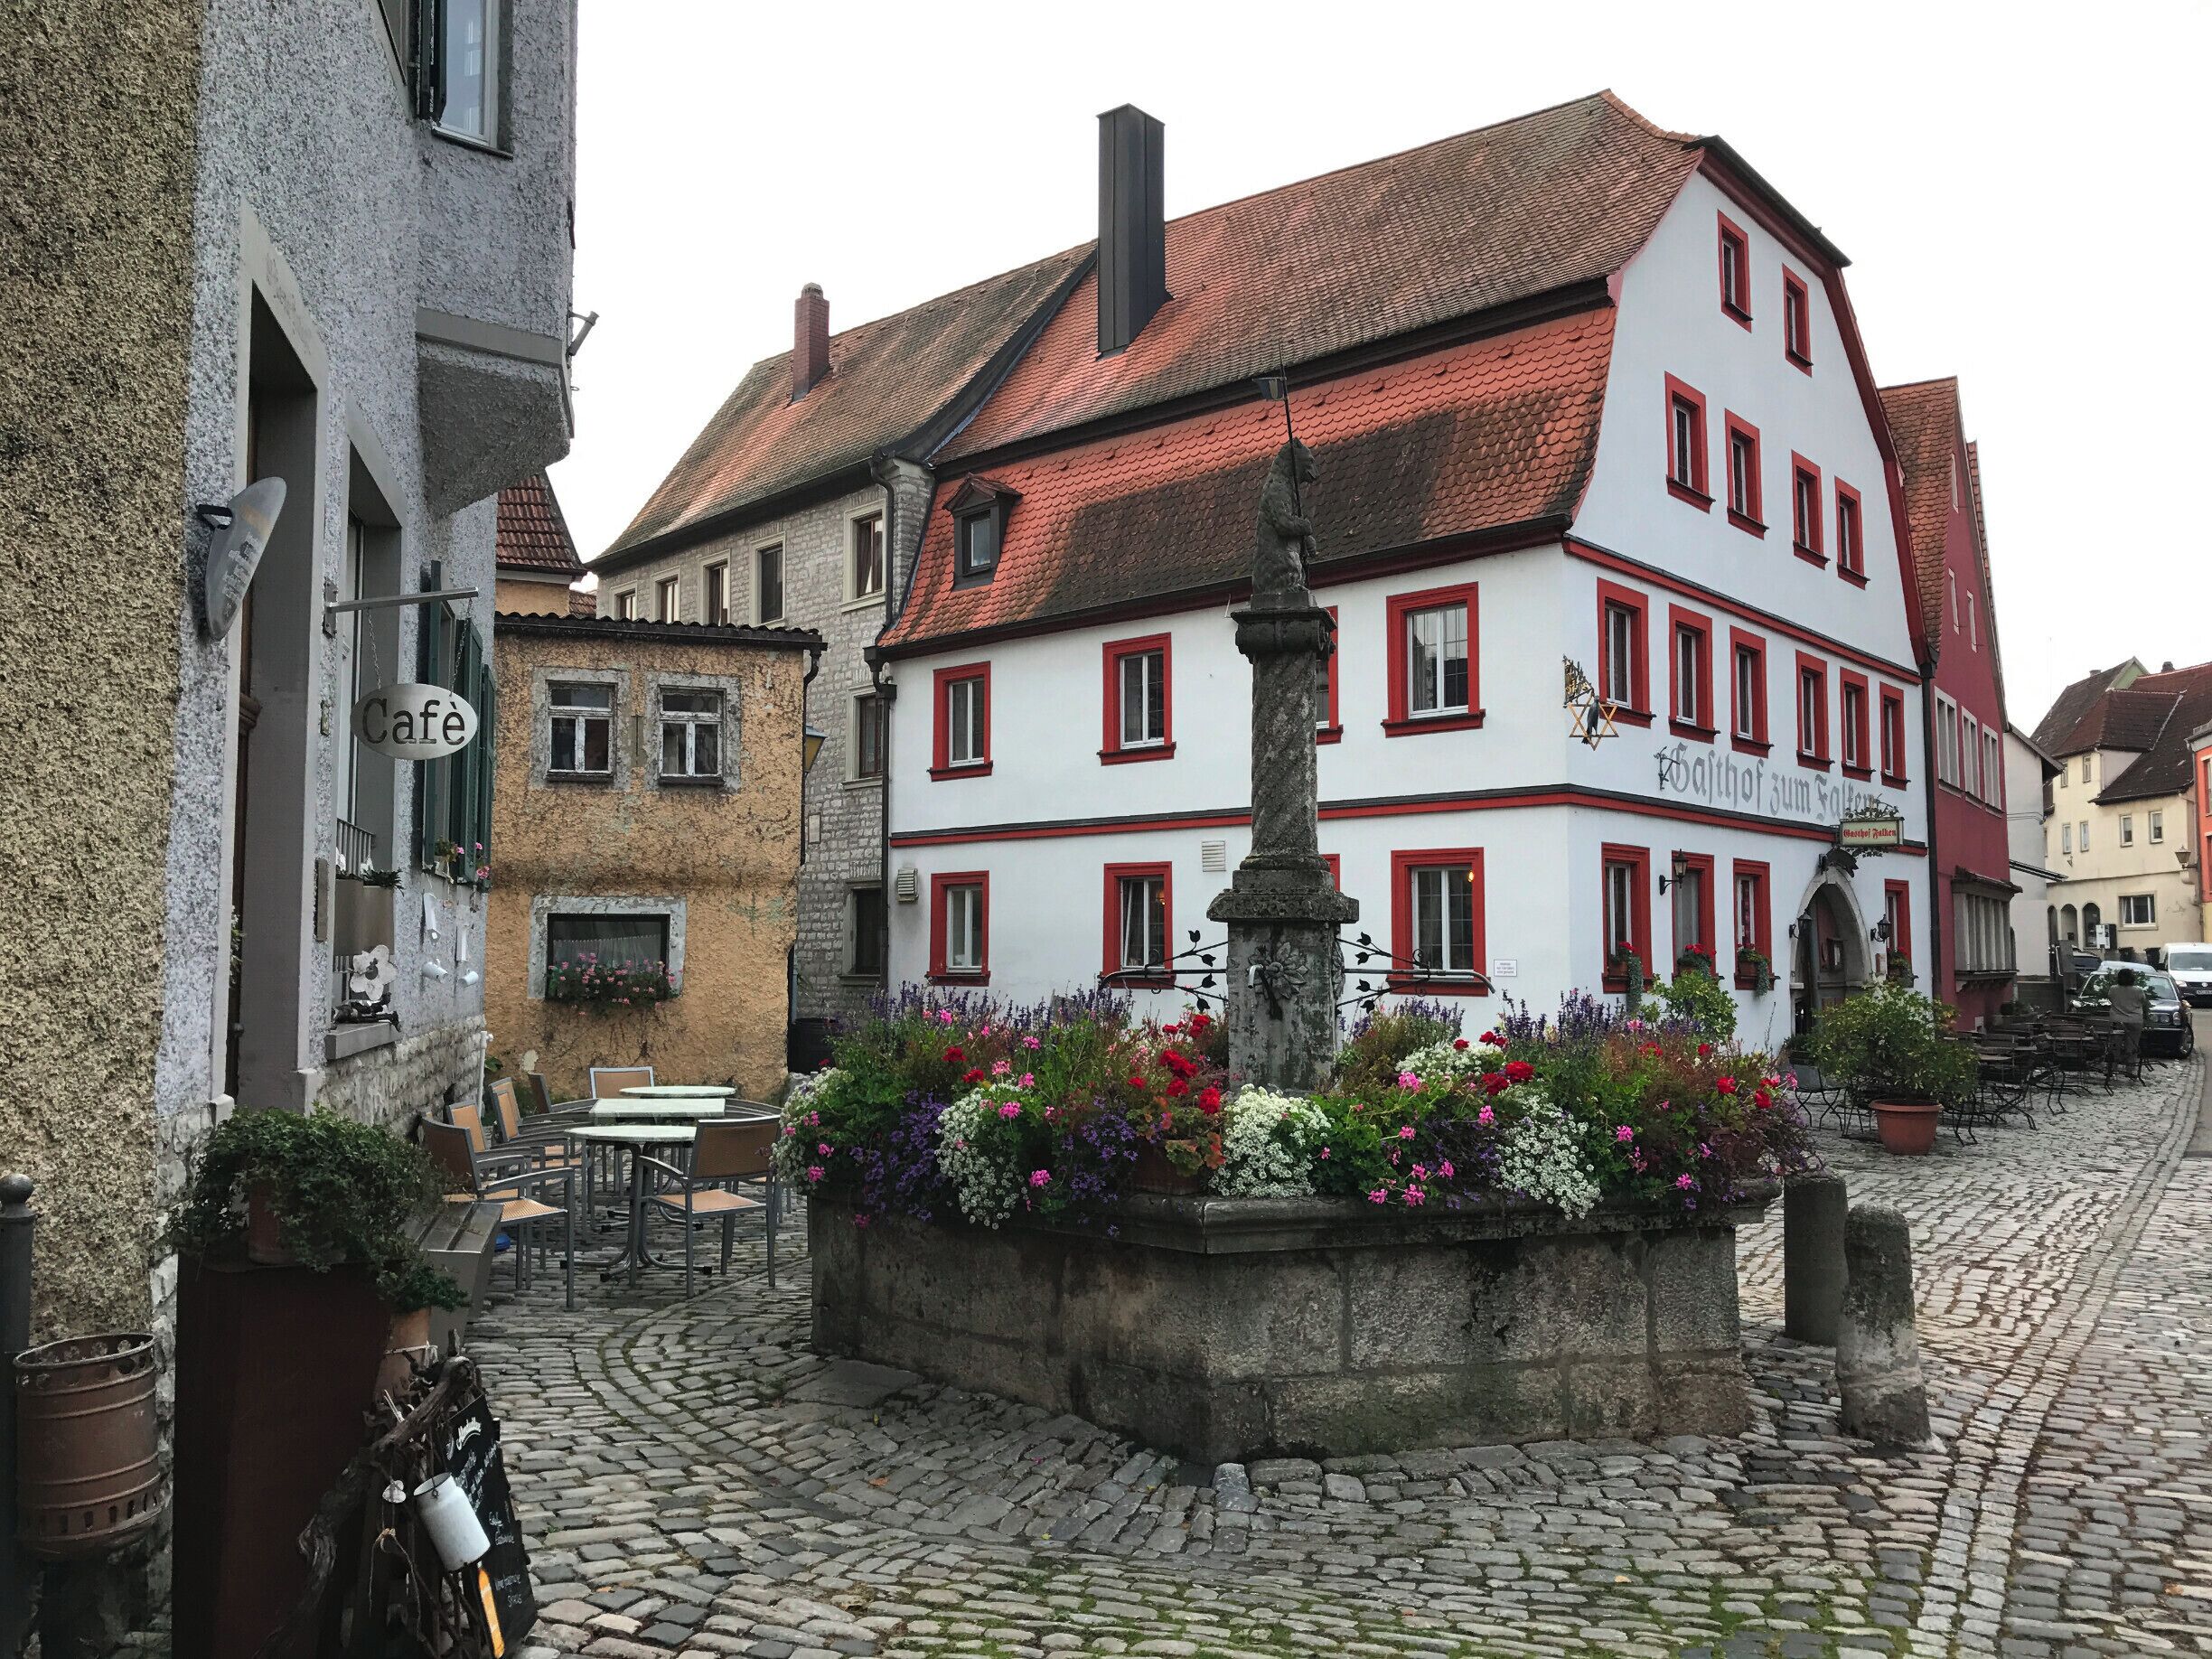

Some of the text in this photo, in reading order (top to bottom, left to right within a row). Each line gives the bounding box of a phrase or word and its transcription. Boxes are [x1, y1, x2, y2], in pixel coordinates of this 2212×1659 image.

[362, 698, 465, 745] Cafè
[1769, 771, 1811, 816] zum
[1843, 828, 1897, 839] Gasthof Falken
